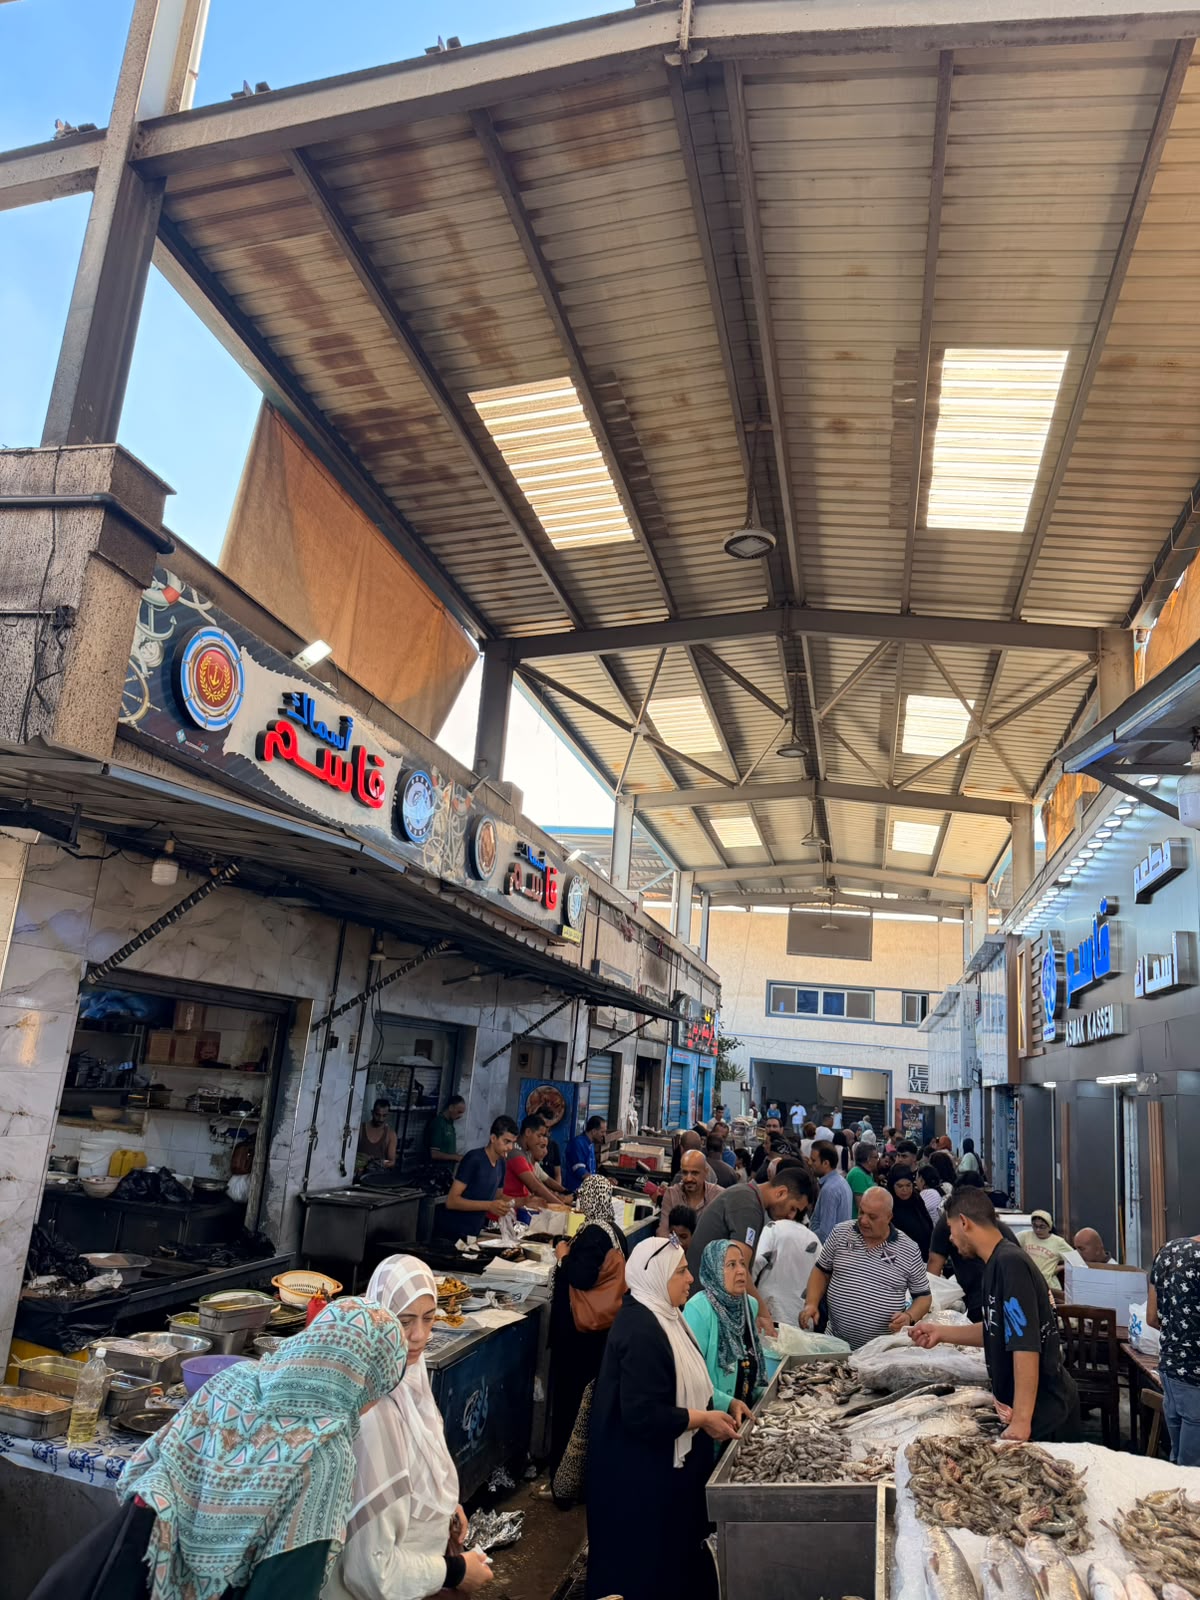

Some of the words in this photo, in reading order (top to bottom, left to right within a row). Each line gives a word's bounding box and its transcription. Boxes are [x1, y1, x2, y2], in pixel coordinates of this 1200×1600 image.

[260, 719, 386, 810] قاسم
[507, 863, 559, 911] قاسم
[1066, 896, 1111, 1009] قاسم
[1064, 1015, 1086, 1047] ASMAK
[1086, 1003, 1114, 1041] KASSEM
